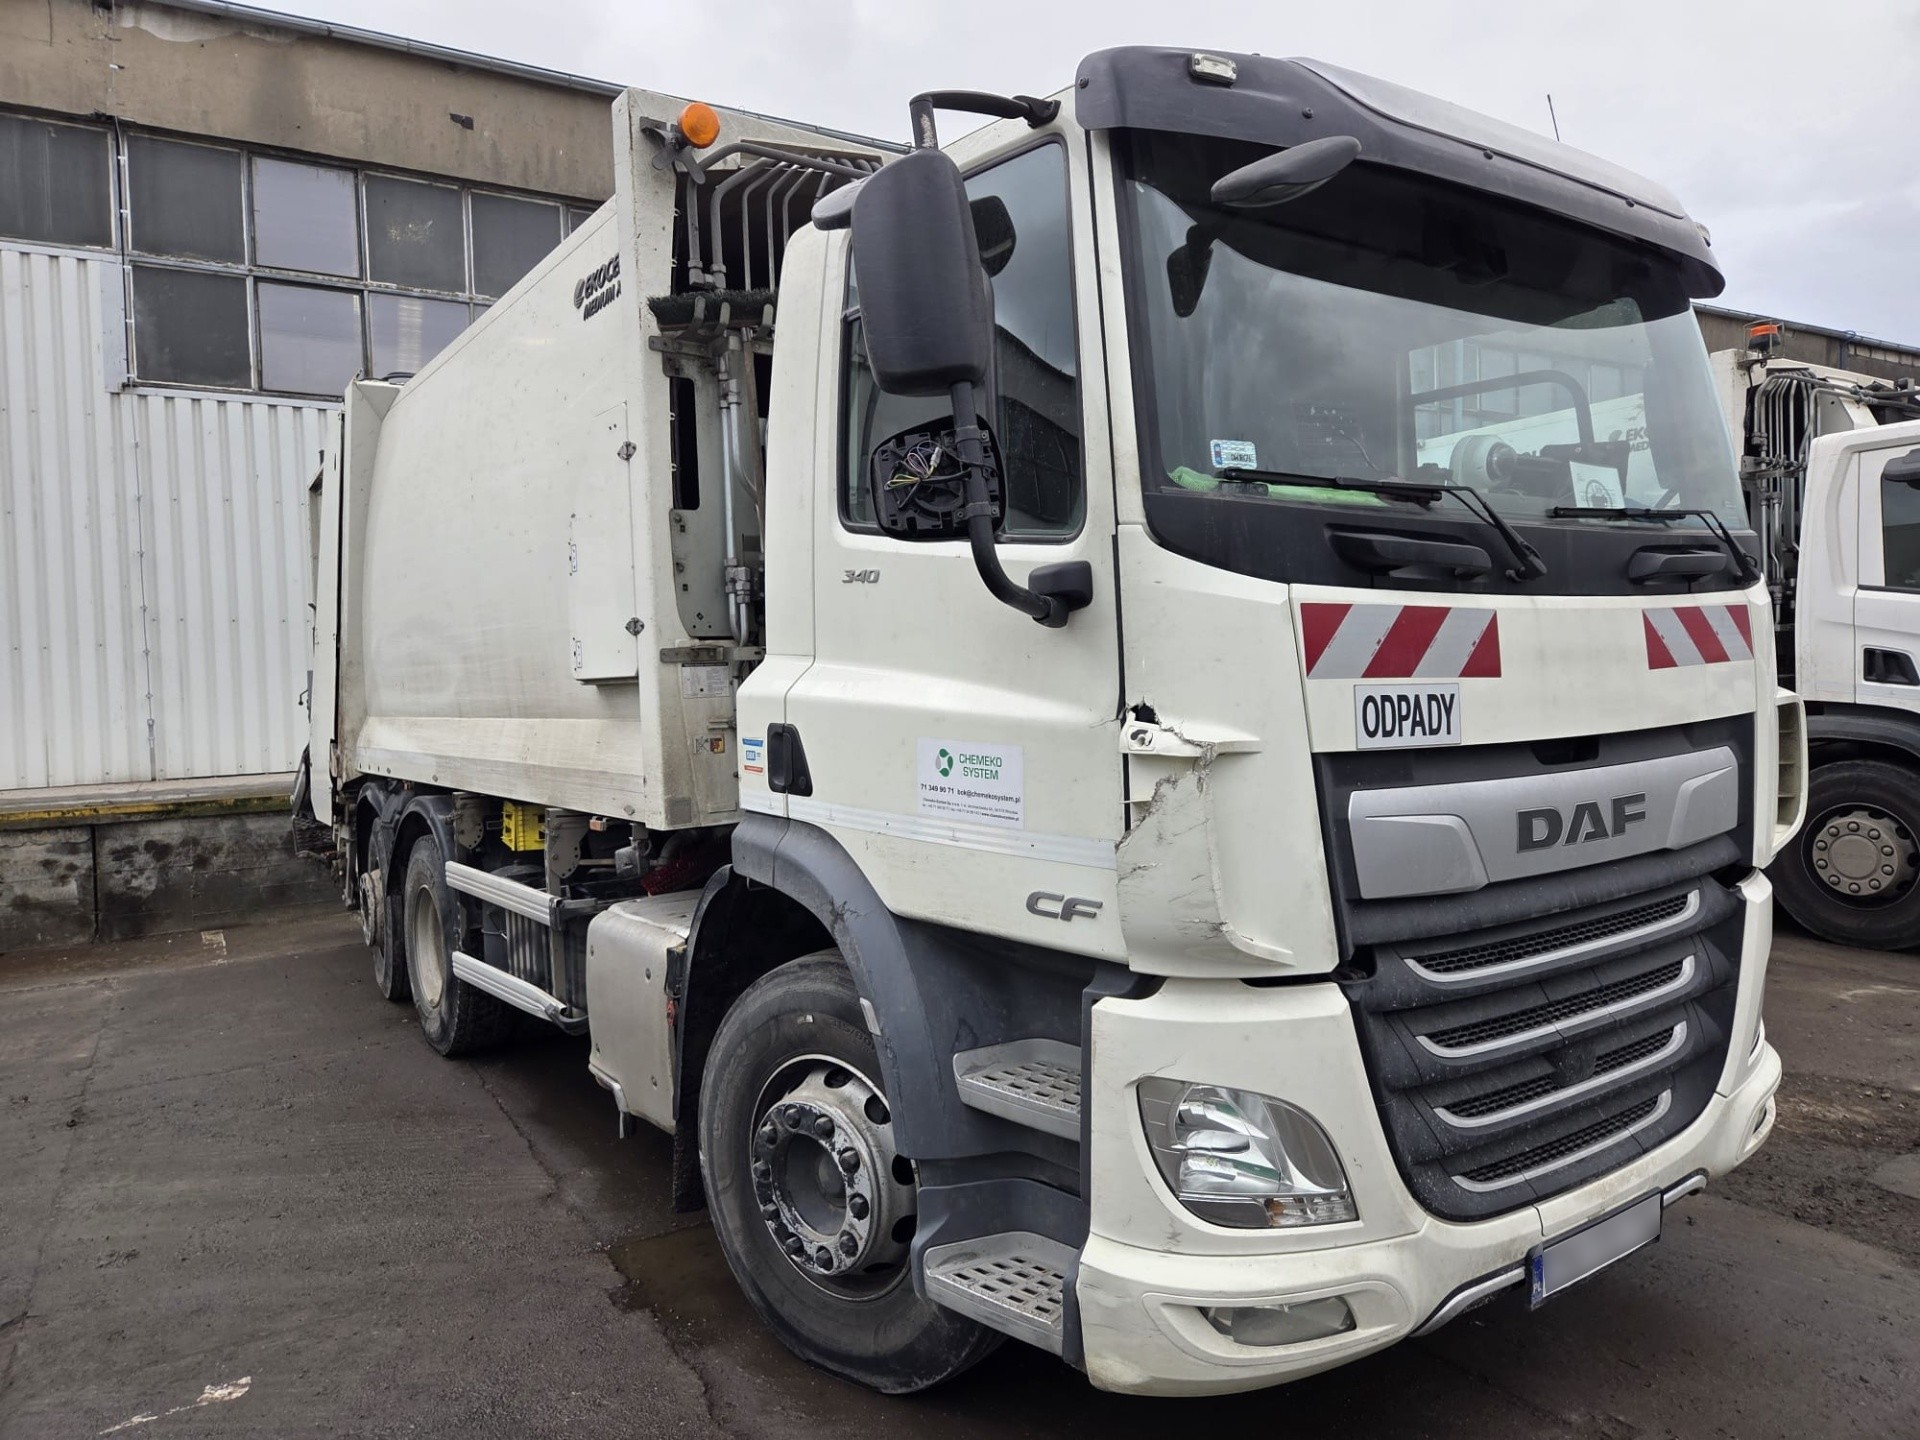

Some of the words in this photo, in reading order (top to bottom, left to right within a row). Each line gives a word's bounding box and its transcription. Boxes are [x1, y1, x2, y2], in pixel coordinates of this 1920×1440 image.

[841, 569, 880, 584] 340
[1362, 693, 1455, 738] ODPADY
[959, 753, 1003, 768] CHEMEKO
[963, 766, 999, 780] SYSTEM
[928, 784, 939, 792] 349
[947, 786, 954, 794] 71
[1517, 791, 1646, 854] DAF
[1026, 891, 1103, 922] CF
[1533, 1281, 1542, 1294] PL
